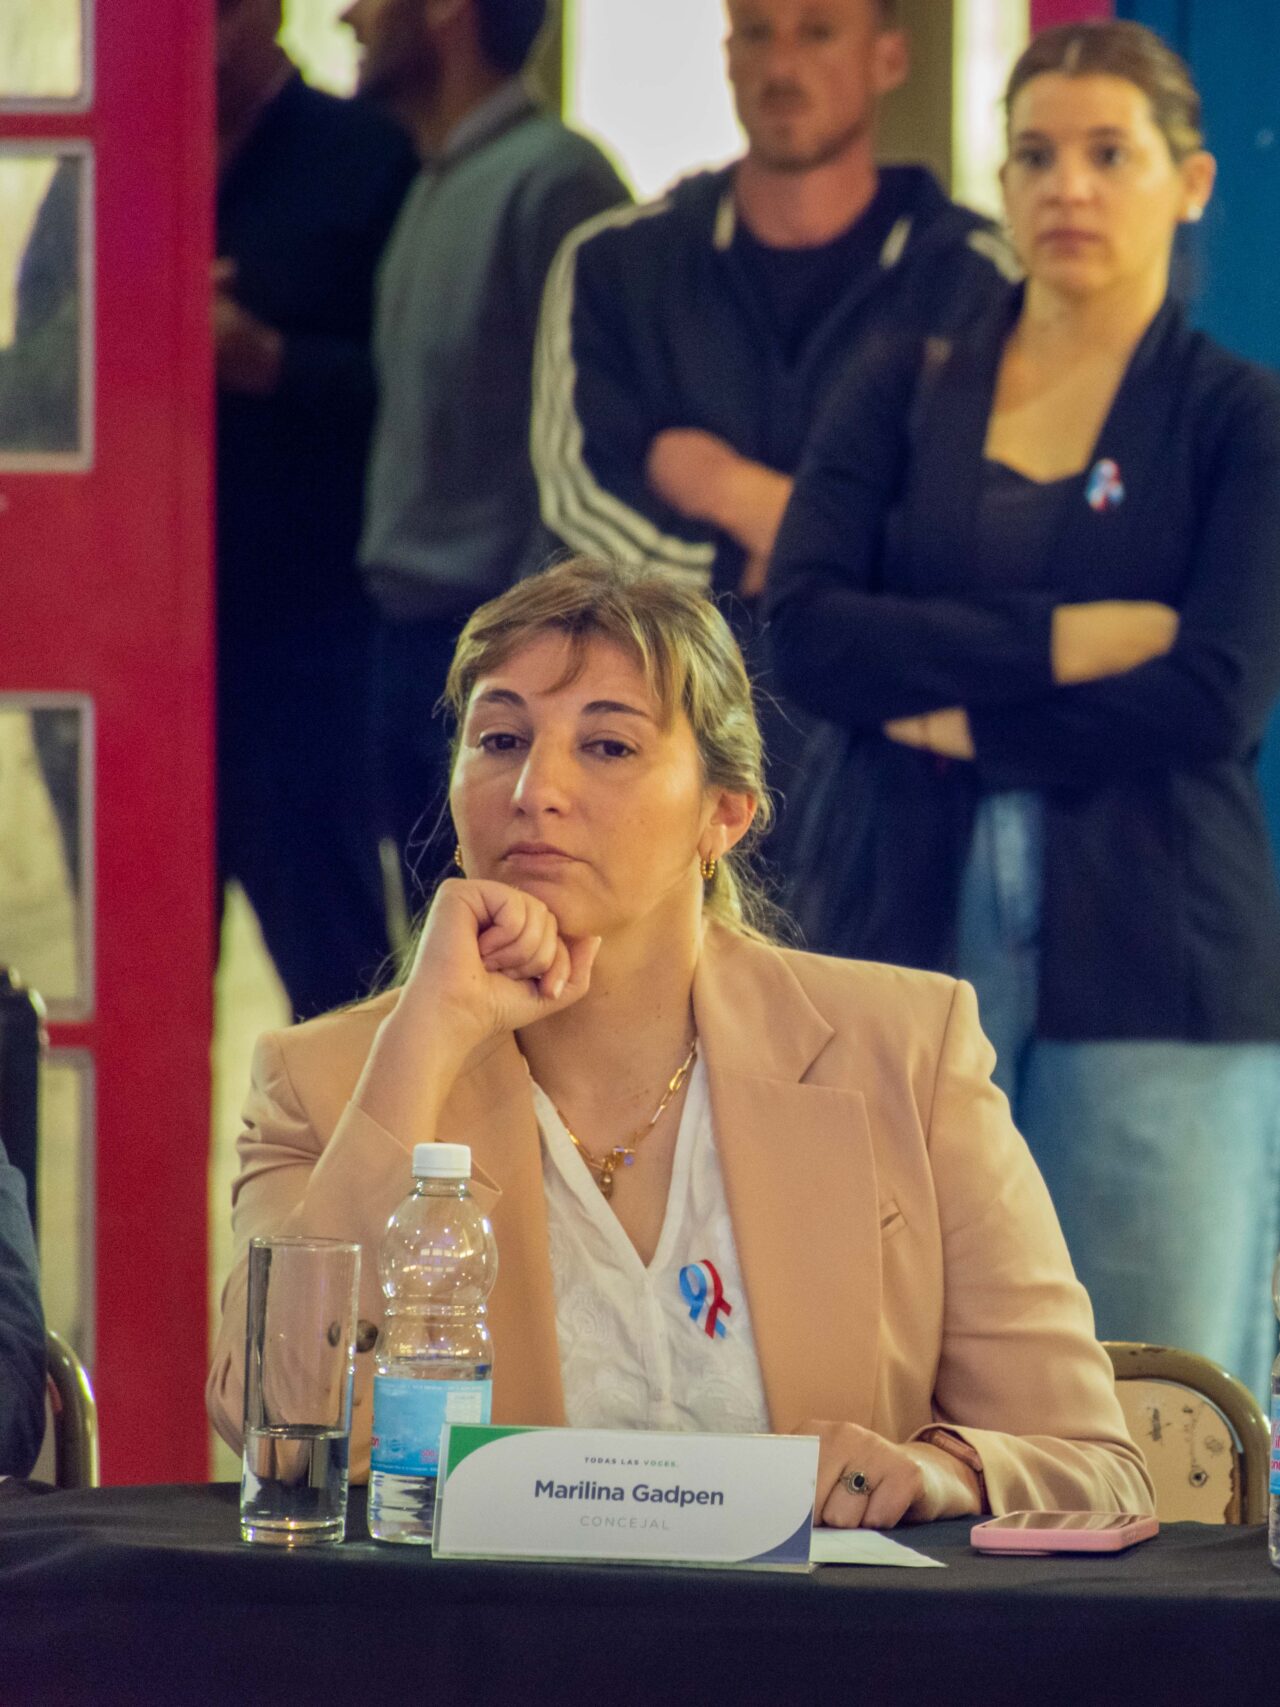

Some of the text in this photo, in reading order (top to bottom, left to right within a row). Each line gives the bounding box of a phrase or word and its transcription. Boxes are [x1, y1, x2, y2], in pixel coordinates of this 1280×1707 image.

[584, 1456, 617, 1465] TODAS
[620, 1458, 640, 1466] LAS
[534, 1479, 724, 1508] Marilina Gadpen
[579, 1515, 671, 1531] CONCEJAL
